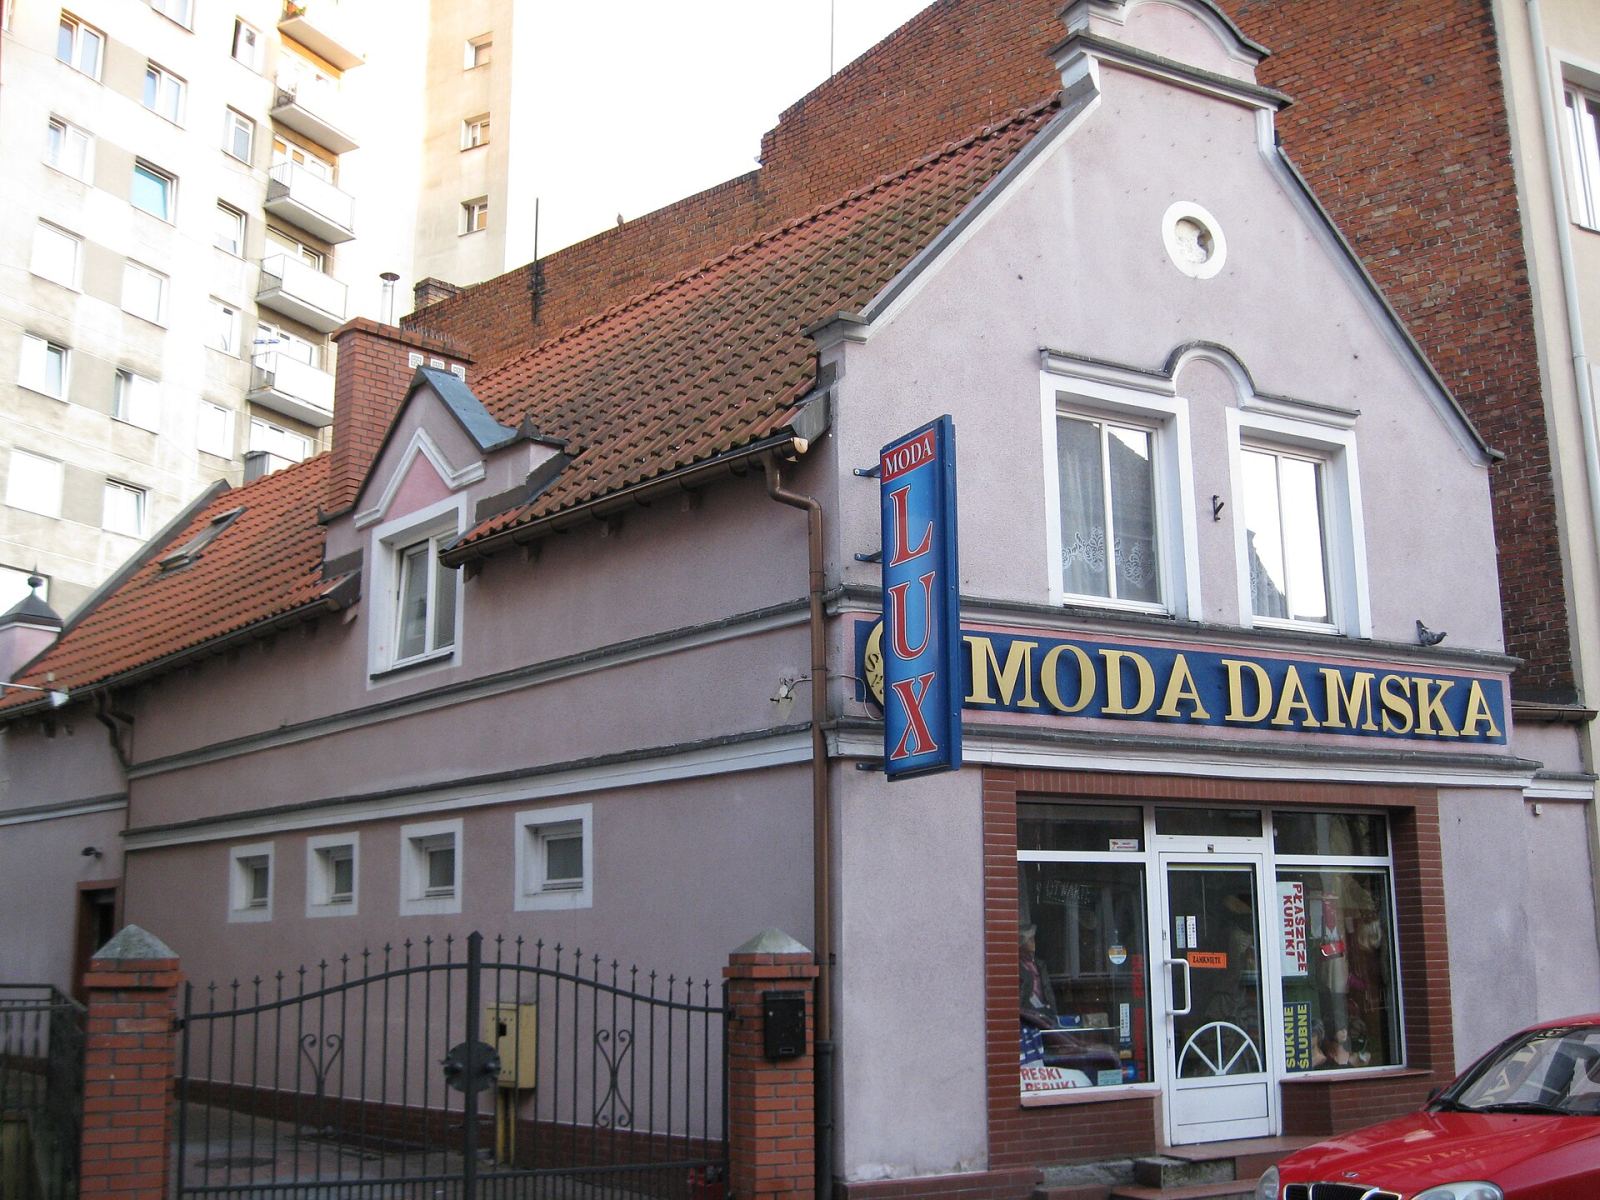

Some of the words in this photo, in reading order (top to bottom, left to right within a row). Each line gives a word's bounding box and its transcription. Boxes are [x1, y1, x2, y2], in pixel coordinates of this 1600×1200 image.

[885, 446, 932, 477] MODA
[888, 485, 938, 761] LUX
[964, 635, 1208, 720] MODA
[1222, 659, 1501, 737] DAMSKA
[1283, 895, 1295, 957] KURTKI
[1292, 883, 1307, 972] PŁASZCZE
[1284, 1006, 1296, 1068] SUKNIE
[1297, 1004, 1309, 1069] ŚLUBNE
